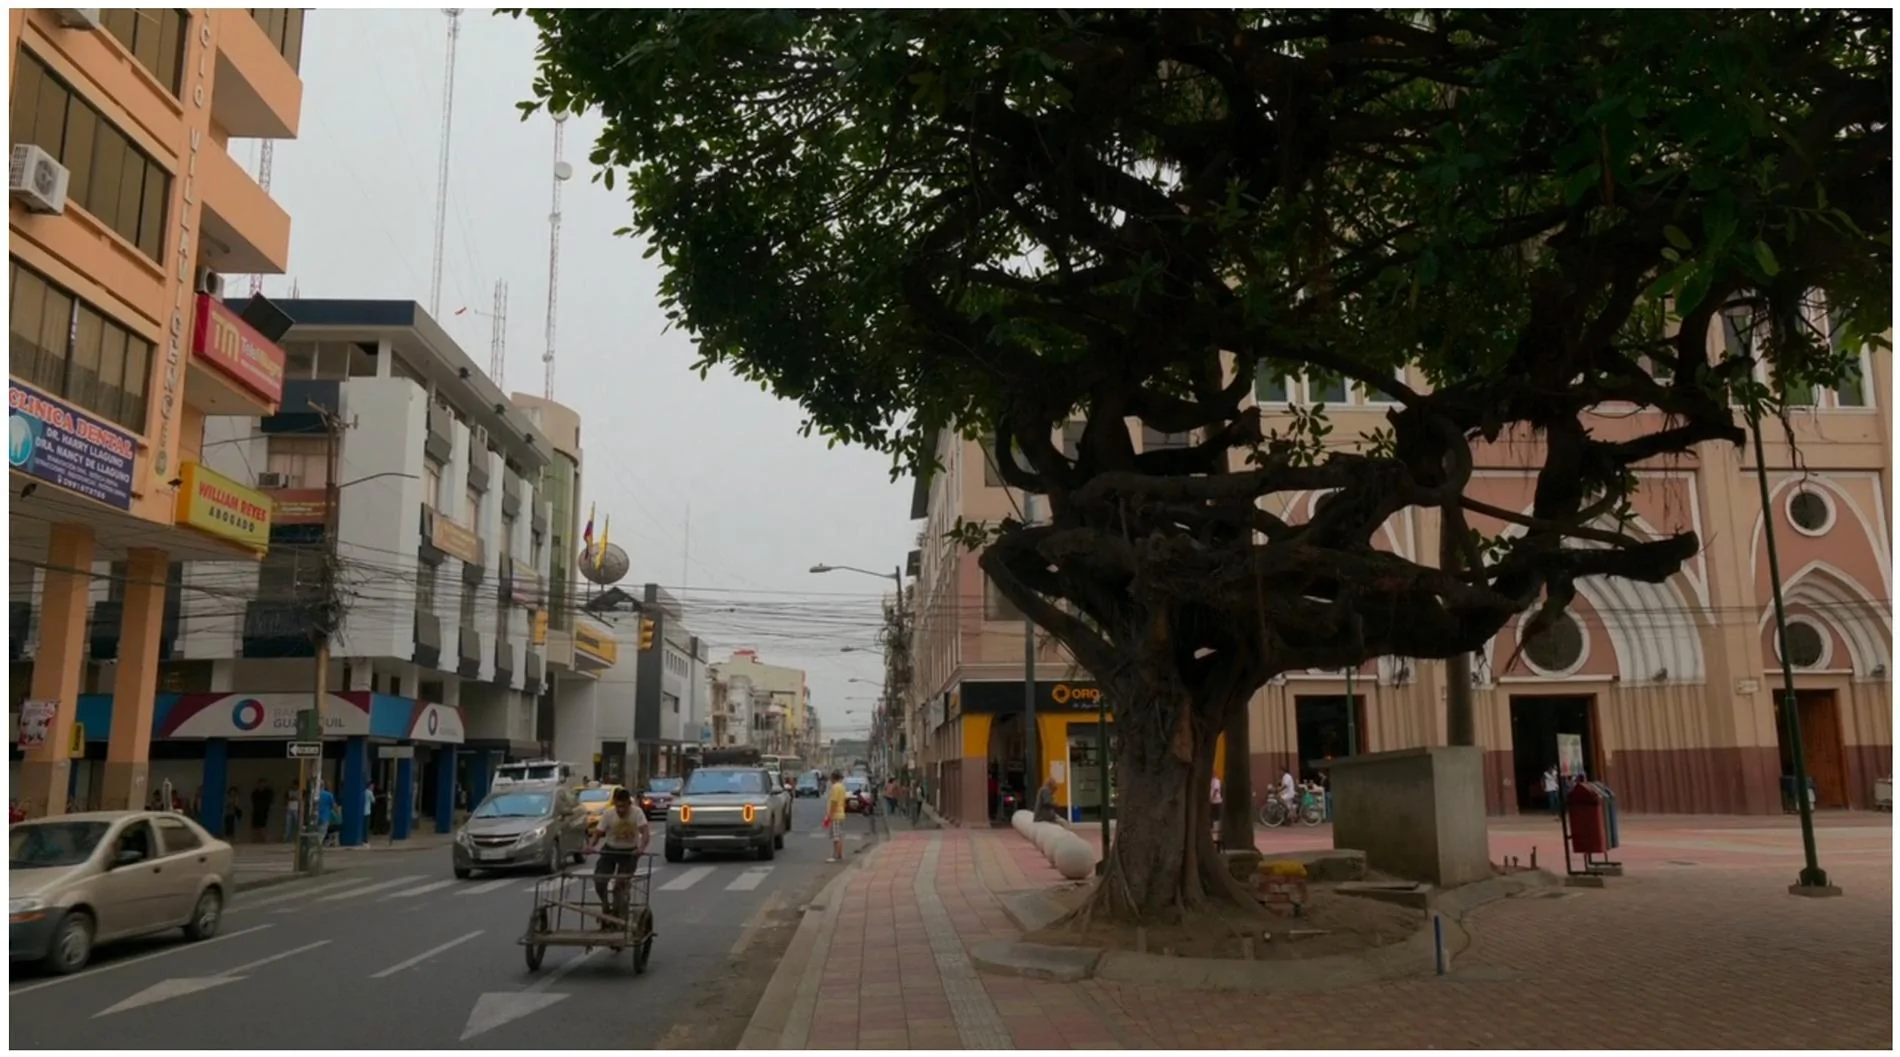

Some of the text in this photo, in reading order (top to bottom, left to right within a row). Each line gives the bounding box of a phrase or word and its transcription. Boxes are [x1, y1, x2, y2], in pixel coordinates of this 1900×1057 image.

[9, 387, 133, 460] CLINICA DENTAL
[61, 434, 90, 453] HARRY
[56, 445, 83, 465] NANCY
[85, 458, 96, 470] DE
[208, 506, 255, 533] ABOGADO
